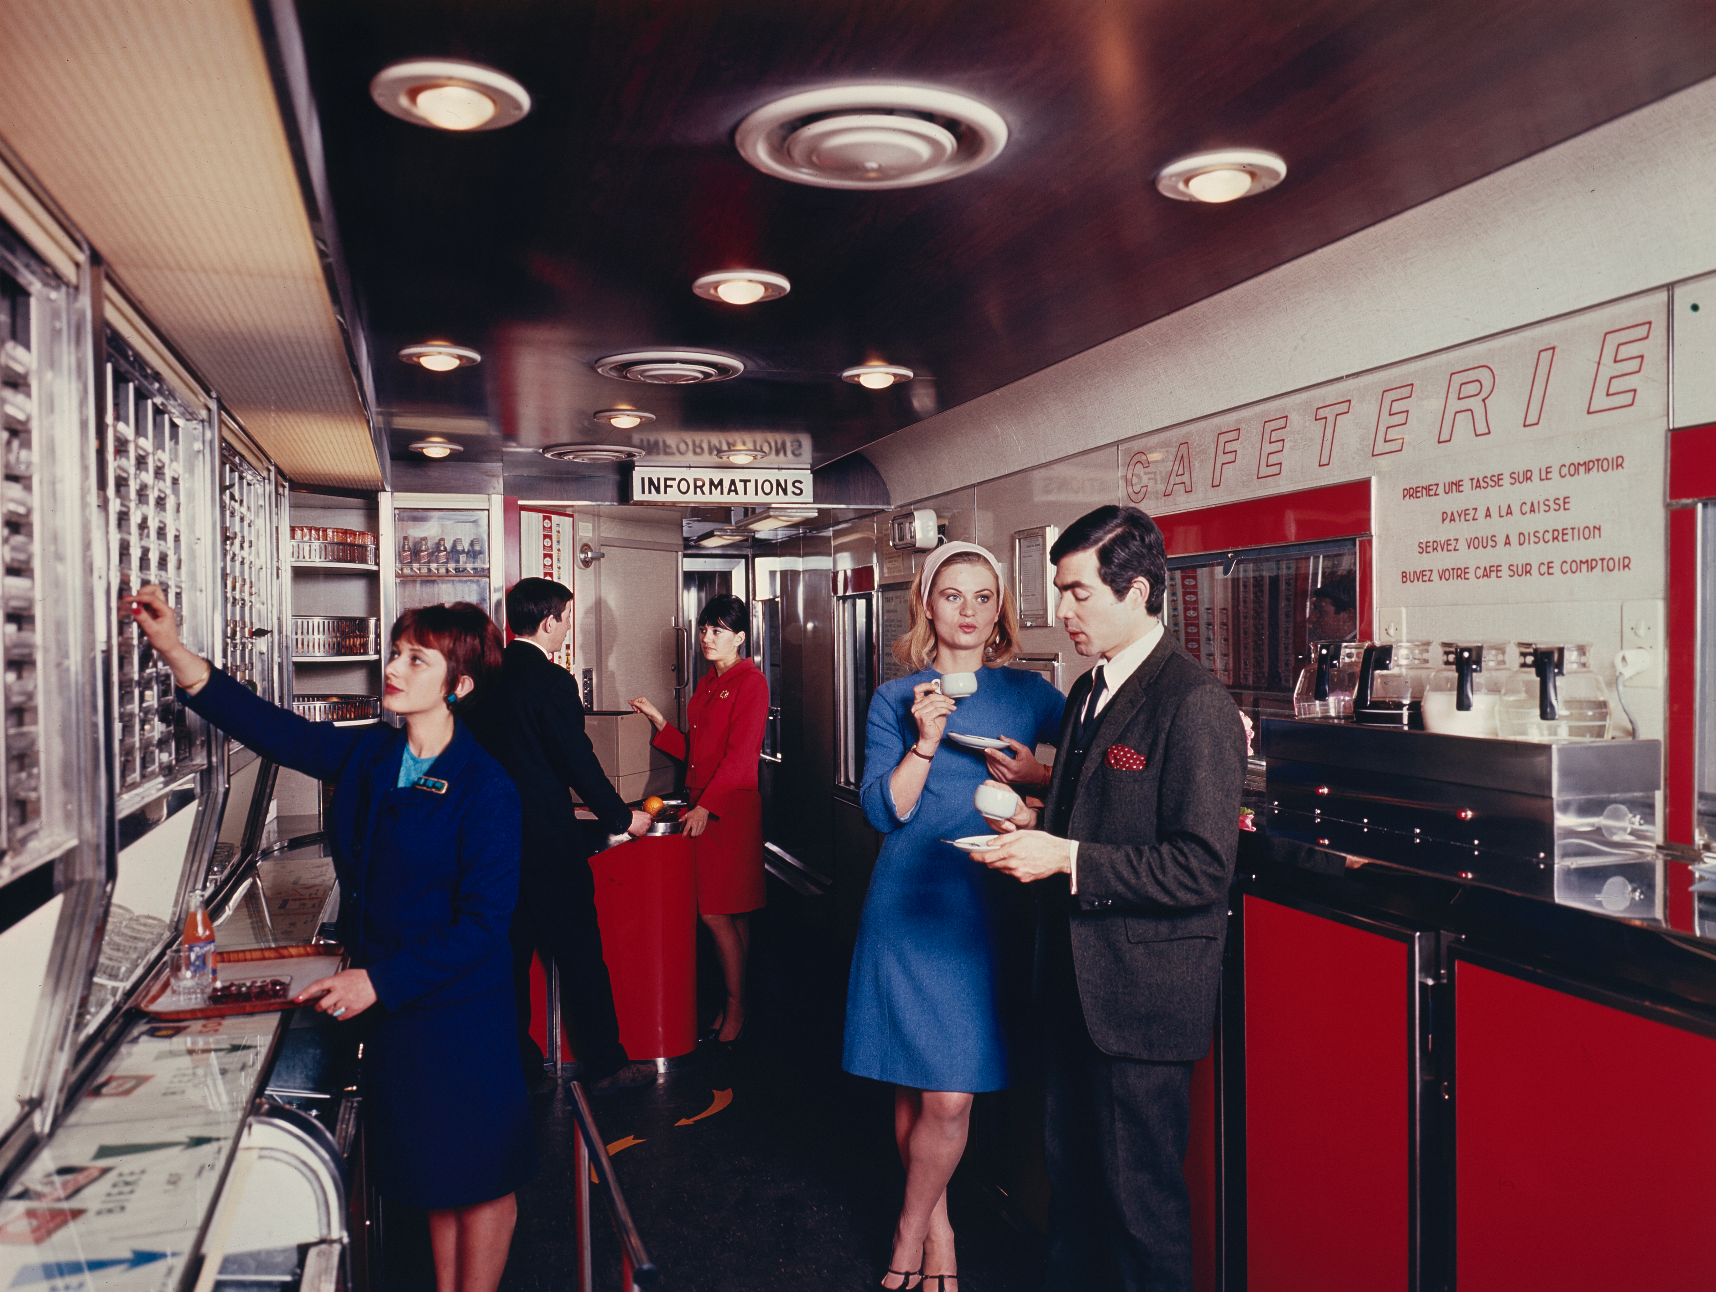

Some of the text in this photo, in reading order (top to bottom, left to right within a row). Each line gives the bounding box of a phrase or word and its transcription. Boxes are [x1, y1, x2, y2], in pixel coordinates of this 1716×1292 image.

[1125, 320, 1653, 504] CAFETERIE
[640, 476, 804, 497] INFORMATIONS
[1402, 455, 1625, 500] PRENEZ UNE TASSE SUR LE COMPTOIR
[1441, 496, 1571, 524] PAYEZ A LA CAISSE
[1417, 524, 1602, 555] SERVEZ VOUS A DISCRETION
[1401, 555, 1632, 584] BUVEZ VOTRE CAFE SUR CE COMPTOIR
